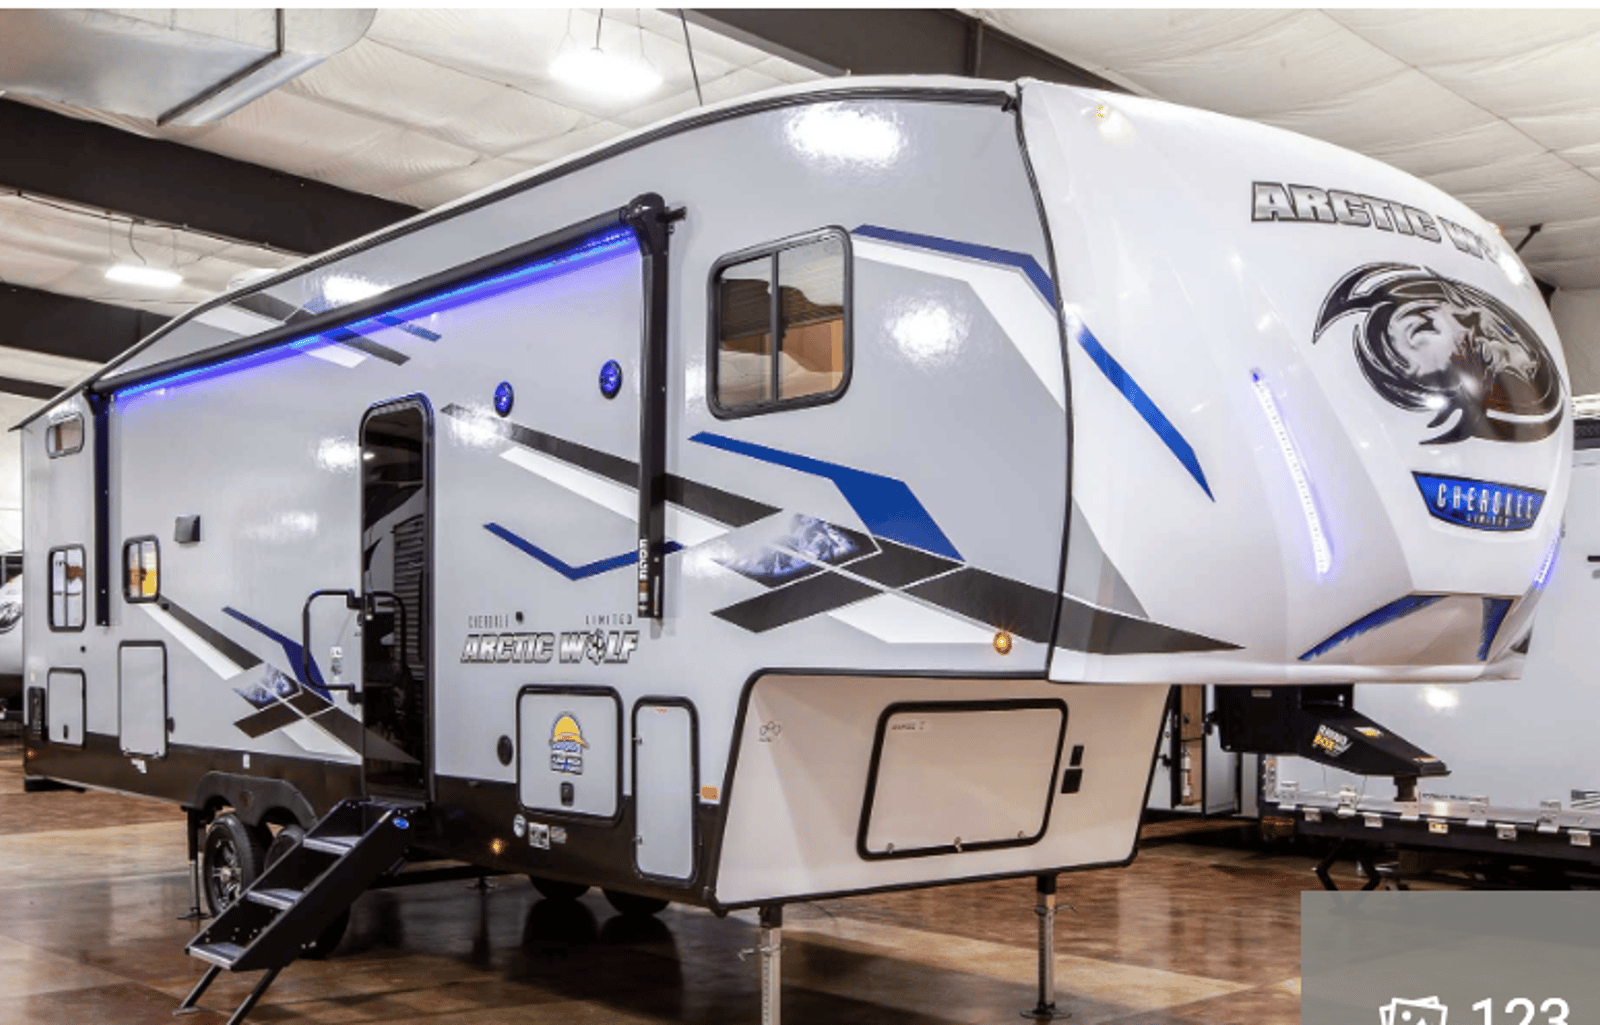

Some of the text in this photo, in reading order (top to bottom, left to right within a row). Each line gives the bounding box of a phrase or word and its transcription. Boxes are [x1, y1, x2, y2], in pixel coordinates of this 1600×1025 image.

[1251, 181, 1441, 243] ARCTIC
[1437, 483, 1533, 519] CHEROKEE
[460, 628, 640, 665] ARCTIC WOLF
